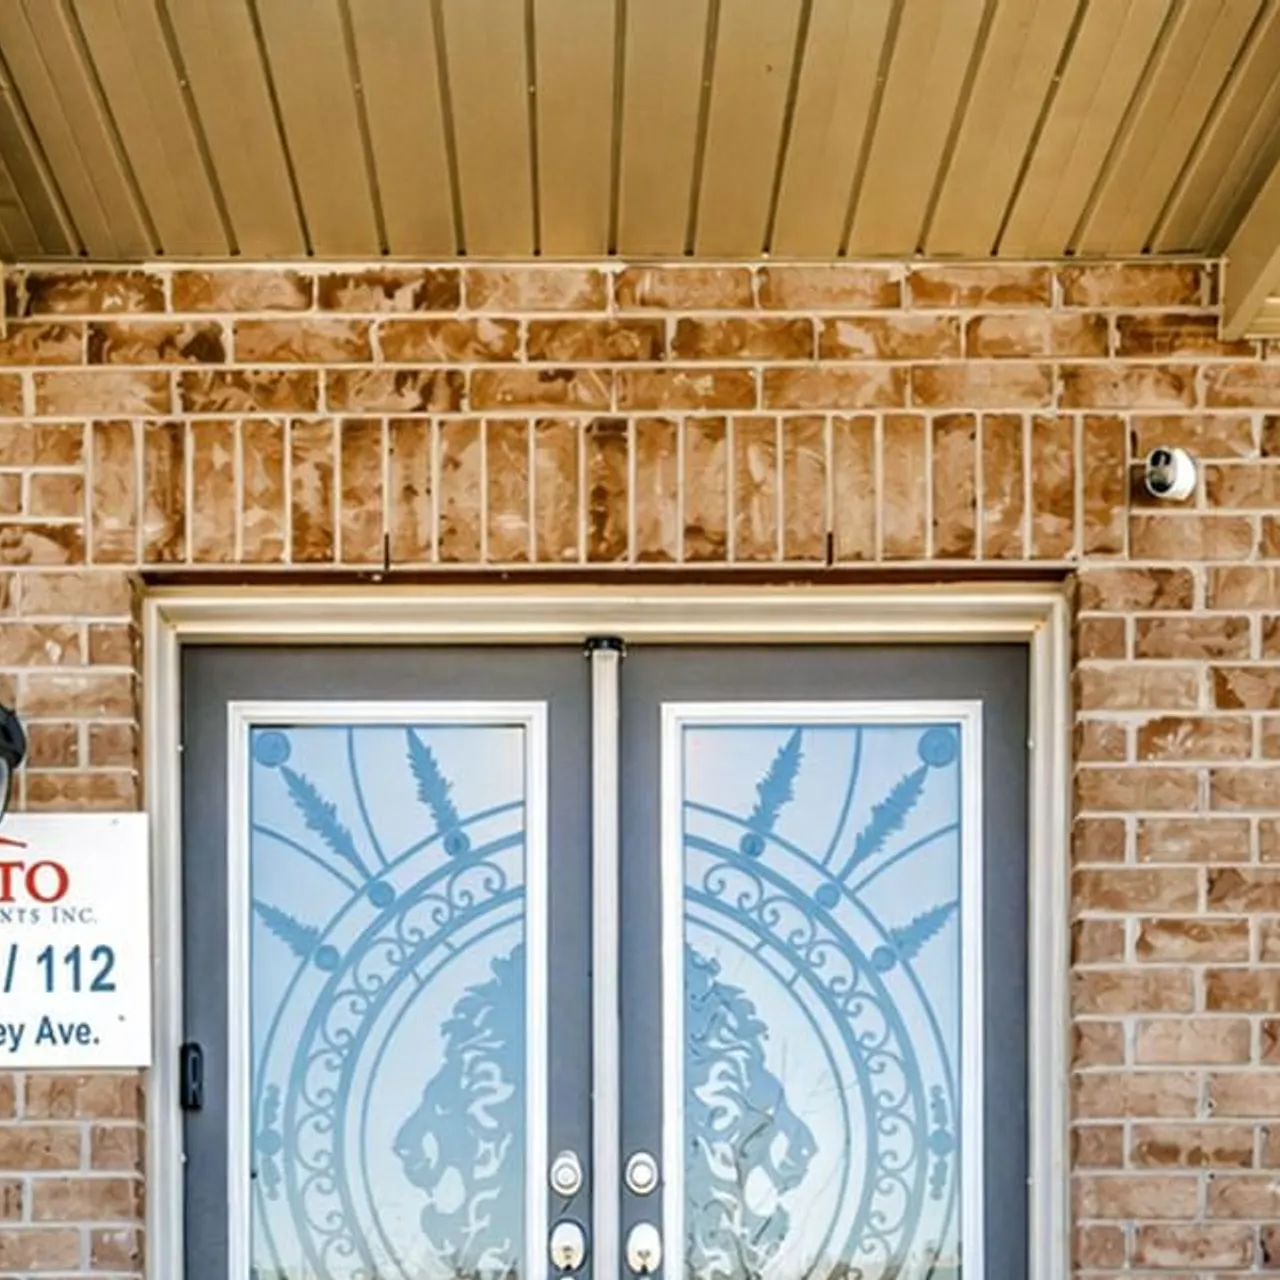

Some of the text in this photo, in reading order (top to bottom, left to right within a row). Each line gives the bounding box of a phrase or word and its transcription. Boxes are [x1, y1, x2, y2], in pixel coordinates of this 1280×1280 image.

[50, 905, 98, 925] INC.
[36, 945, 116, 992] 112
[35, 1016, 100, 1046] Ave.
